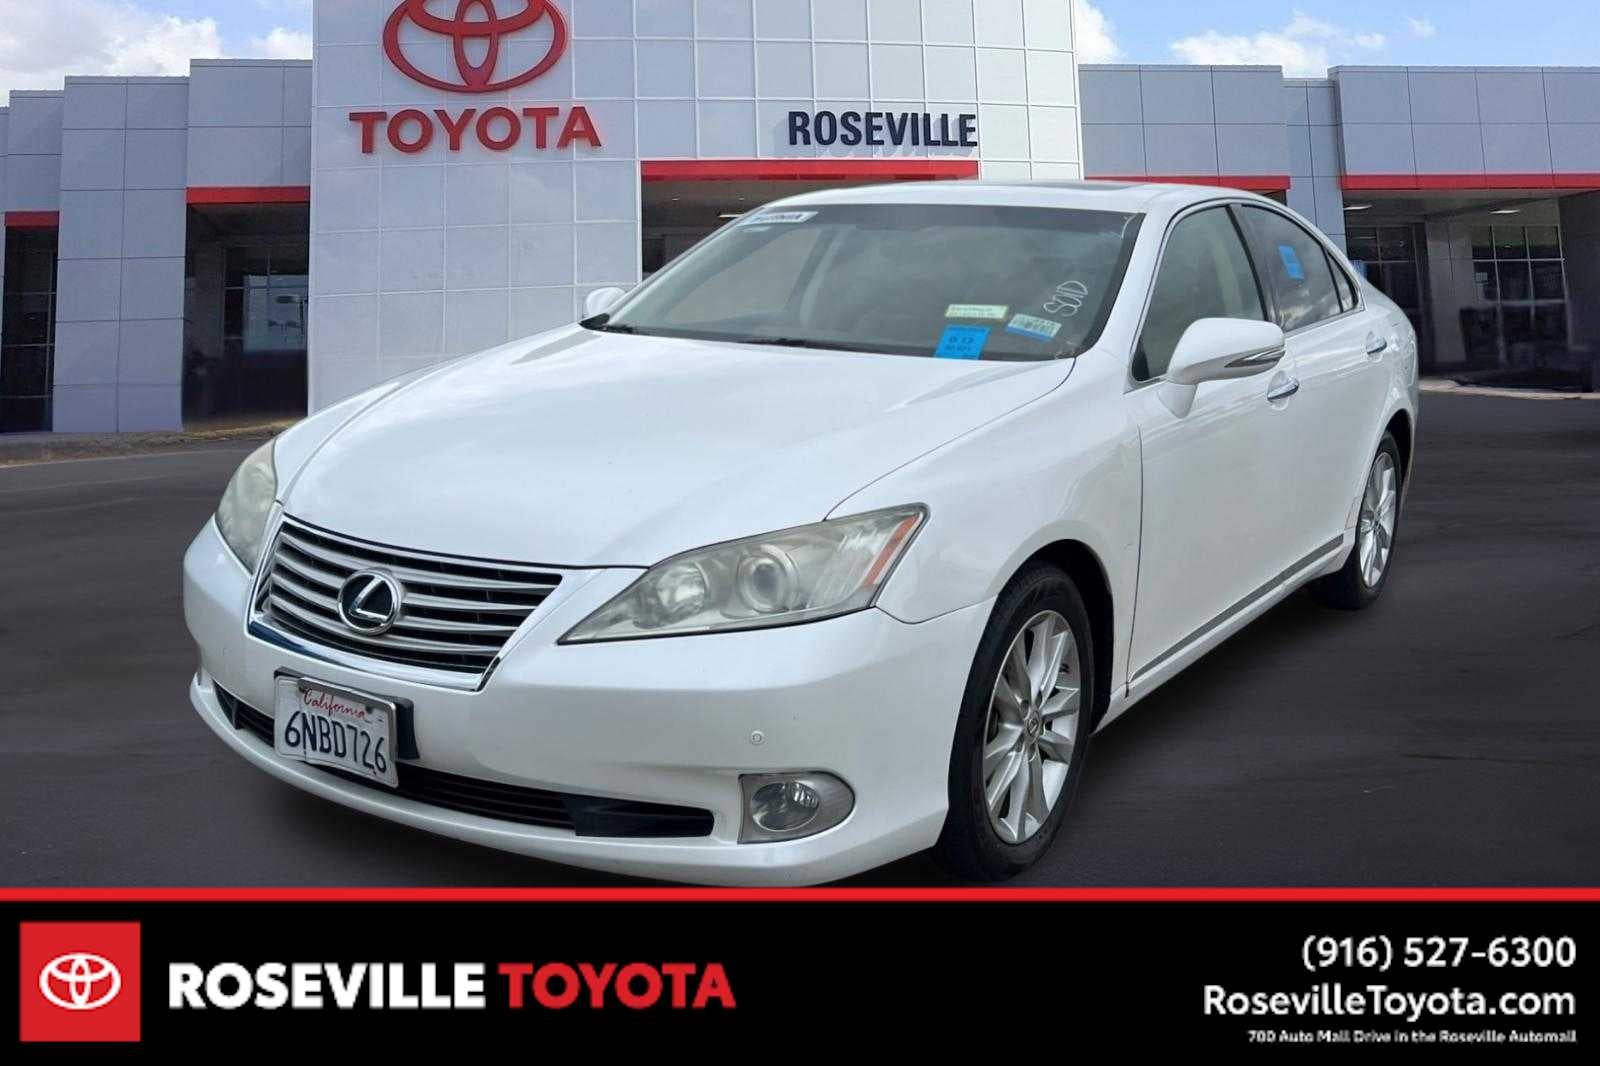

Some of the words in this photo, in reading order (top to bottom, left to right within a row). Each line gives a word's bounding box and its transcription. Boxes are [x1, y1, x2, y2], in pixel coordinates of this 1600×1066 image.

[349, 105, 602, 154] TOYOTA
[789, 111, 978, 147] ROSEVILLE
[302, 687, 369, 721] California
[284, 710, 387, 774] 6NBD726
